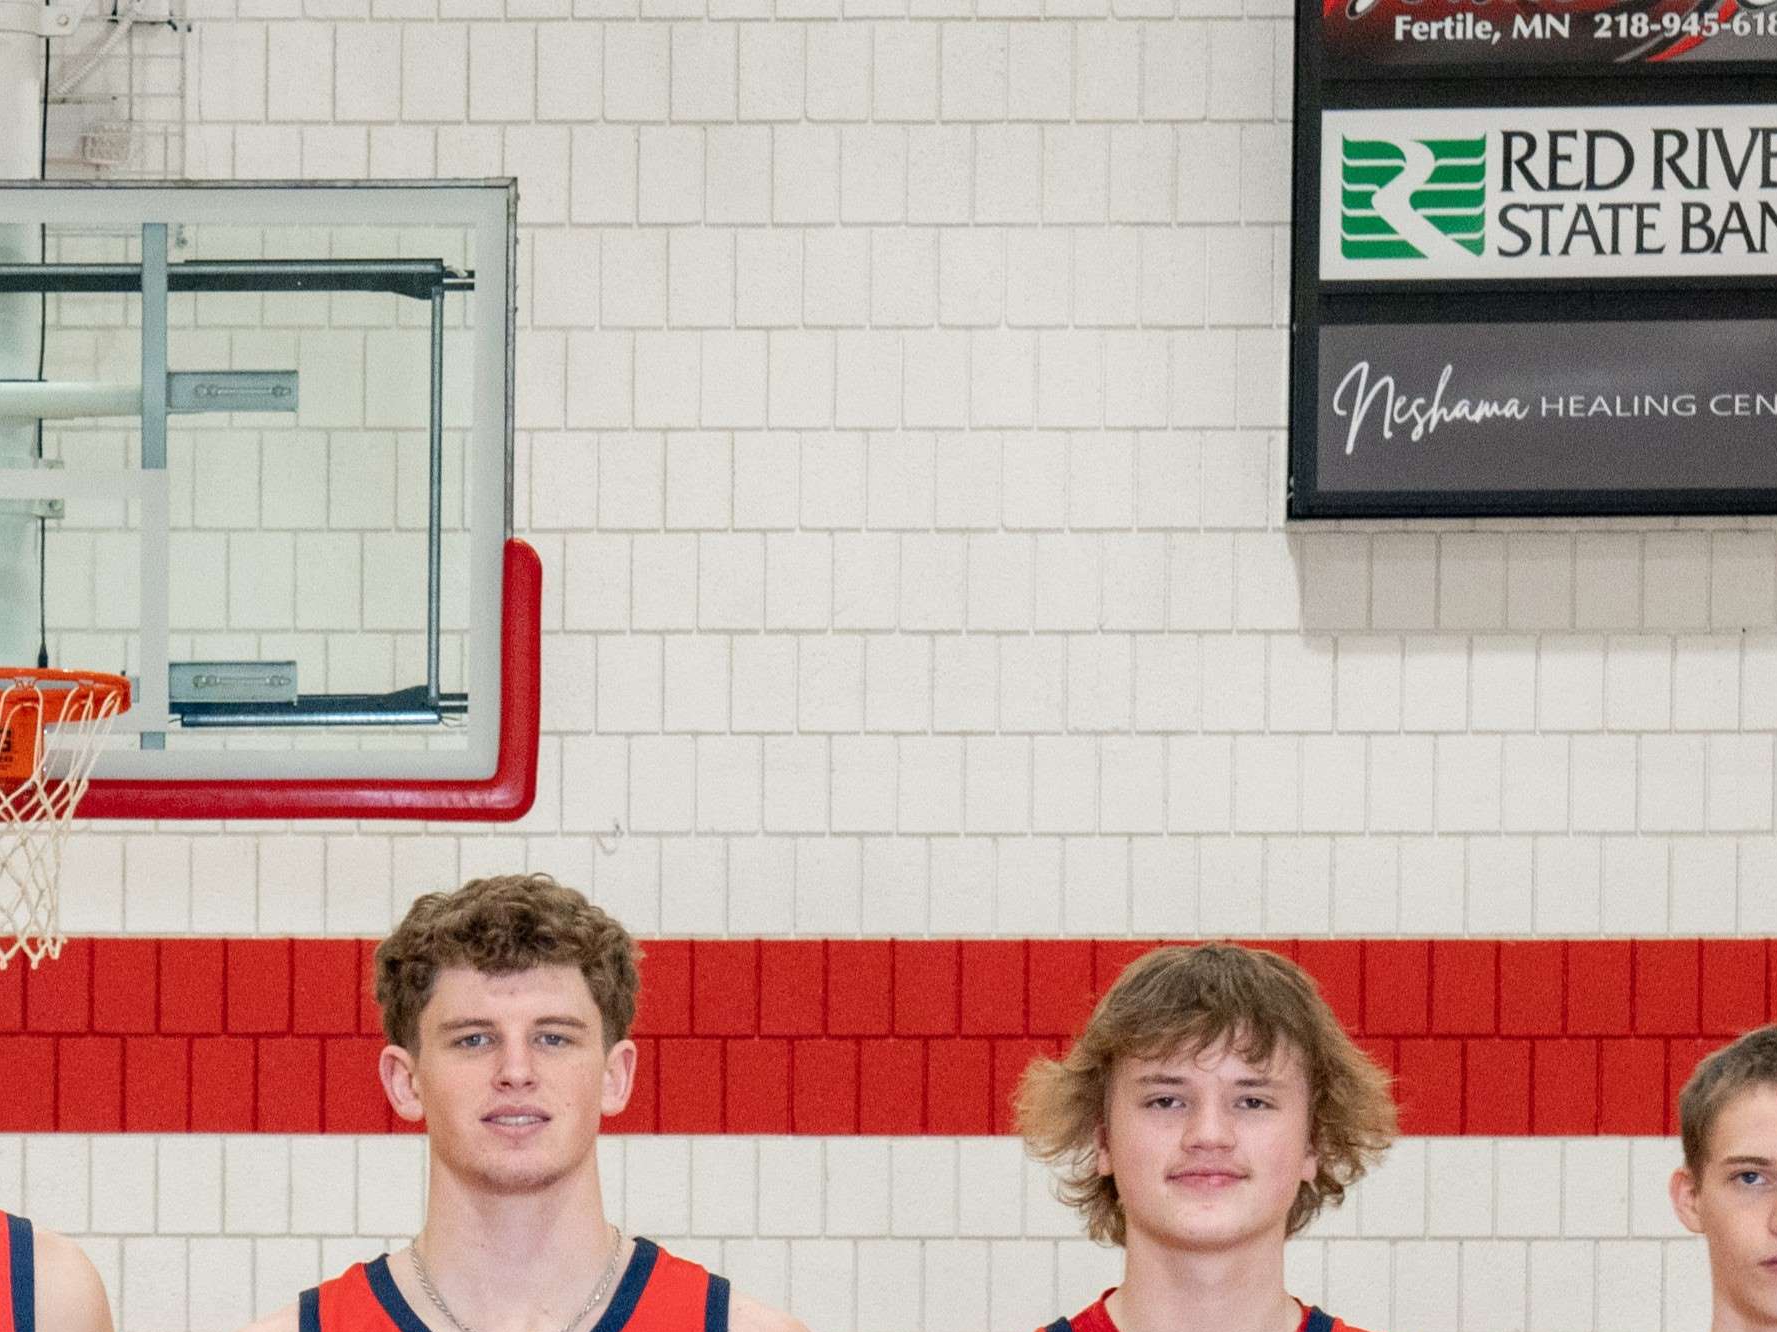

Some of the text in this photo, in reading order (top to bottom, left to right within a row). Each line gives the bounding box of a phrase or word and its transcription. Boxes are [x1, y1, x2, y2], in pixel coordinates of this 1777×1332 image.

[1394, 14, 1501, 45] Fertile,
[1512, 14, 1570, 40] MN
[1499, 130, 1635, 192] RED
[1497, 203, 1665, 258] STATE
[1332, 362, 1529, 455] Neshama
[1540, 394, 1696, 418] HEALING
